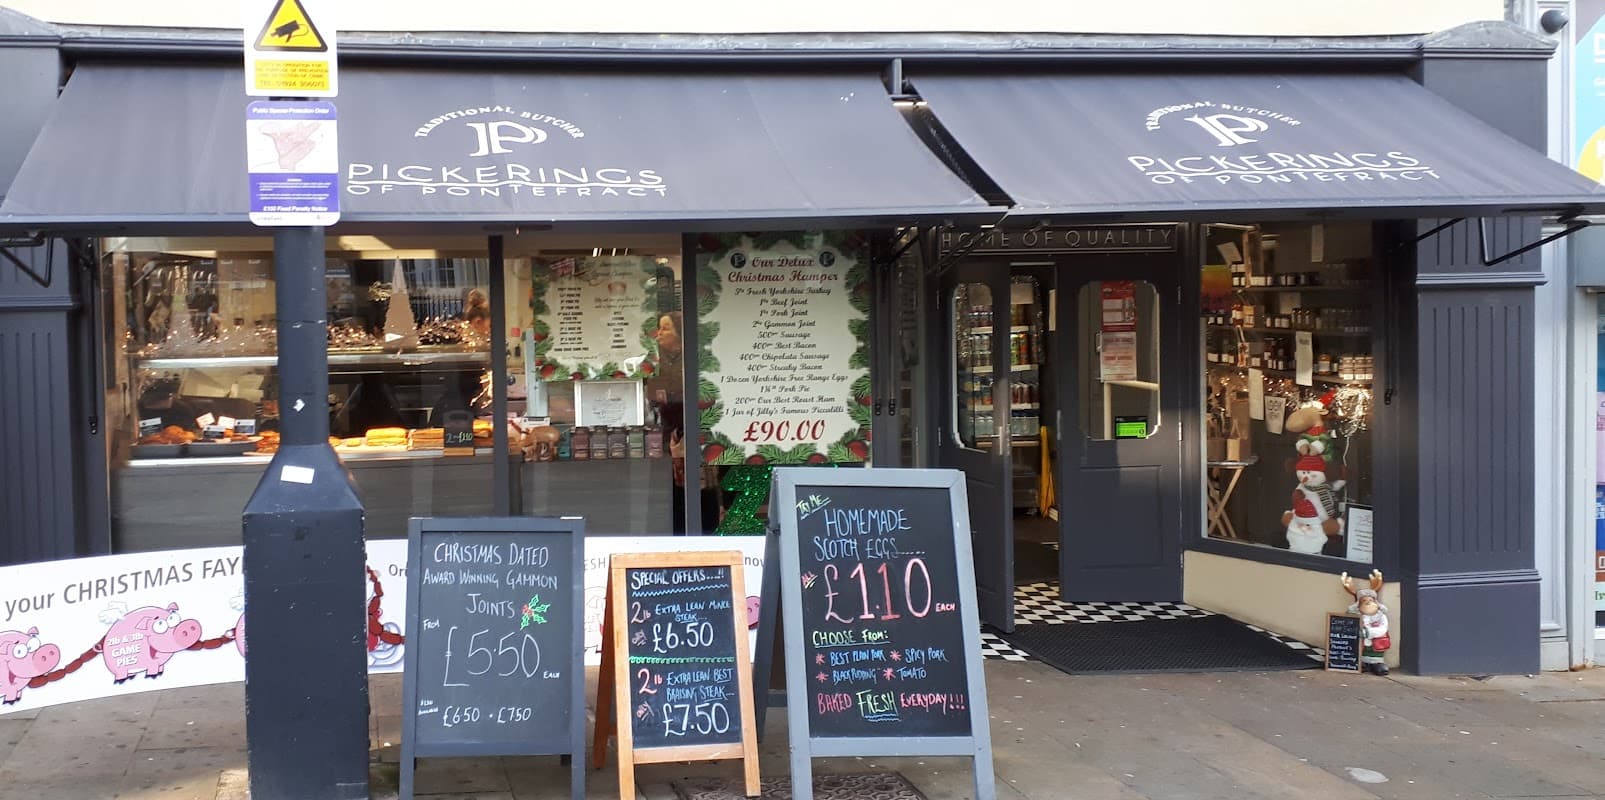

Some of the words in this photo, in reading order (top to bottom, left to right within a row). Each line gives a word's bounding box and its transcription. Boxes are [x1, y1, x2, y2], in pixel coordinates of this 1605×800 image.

[414, 104, 514, 138] TRADITIONAL
[520, 110, 585, 139] BUTCHER
[1145, 100, 1216, 132] TRADITIONAL
[1220, 103, 1303, 127] BUTCHER
[1127, 152, 1421, 173] PICKERINGS
[348, 163, 666, 185] PICKERINGS
[1151, 173, 1195, 185] OF
[1218, 170, 1441, 185] PONTEFRACT
[346, 184, 394, 196] OF
[422, 184, 667, 198] PONTEFRACT
[1023, 230, 1053, 247] OF
[1065, 229, 1172, 247] QUALITY
[752, 256, 773, 268] Our
[728, 271, 785, 283] Christmas
[788, 270, 838, 284] Hamper
[768, 287, 804, 297] Yorkshire
[770, 298, 787, 308] Beef
[790, 298, 808, 308] Joint
[770, 309, 788, 317] Pork
[790, 309, 808, 318] Joint
[764, 320, 796, 329] Gammon
[798, 319, 816, 329] Joint
[780, 331, 811, 339] Sausage
[774, 341, 791, 349] Best
[793, 341, 817, 349] Bacon
[761, 352, 797, 362] Chipolata
[800, 352, 830, 361] Sausage
[769, 363, 797, 372] Streaky
[799, 363, 823, 371] Bacon
[725, 375, 749, 383] Dozen
[751, 374, 787, 384] Yorkshire
[788, 374, 804, 382] Free
[805, 373, 830, 382] Range
[831, 373, 849, 382] Eggs
[778, 385, 797, 393] Pork
[798, 384, 810, 392] Pie
[757, 396, 772, 404] Our
[773, 396, 790, 404] Best
[792, 396, 814, 404] Roast
[816, 395, 836, 403] Ham
[732, 408, 744, 416] Jar
[746, 408, 755, 417] of
[780, 406, 809, 414] Famous
[743, 418, 826, 443] £90.00
[824, 508, 912, 537] HOMEMADE
[434, 542, 502, 565] CHRISTMAS
[508, 542, 549, 568] DATED
[813, 536, 860, 562] SCOTCH
[422, 567, 455, 585] AWARD
[459, 568, 499, 589] WINNING
[506, 569, 558, 590] GAMMON
[631, 569, 669, 590] SPECIAL
[5, 589, 55, 622] your
[63, 561, 194, 606] CHRISTMAS
[824, 558, 932, 624] £1.10
[935, 602, 956, 612] EACH
[466, 592, 515, 618] JOINTS
[655, 603, 681, 616] EXTRA
[685, 602, 705, 611] LEAN
[652, 622, 714, 654] £6.50
[812, 630, 857, 646] CHOOSE
[862, 628, 889, 643] FROM:
[112, 643, 142, 658] GAME
[830, 650, 850, 667] BEST
[852, 649, 869, 662] PLAIN
[871, 648, 887, 662] PORK
[904, 647, 926, 665] SPICY
[928, 647, 949, 663] PORK
[116, 655, 138, 668] PIES
[543, 670, 560, 680] EACH
[666, 671, 691, 687] EXTRA
[692, 668, 710, 682] LEAN
[714, 668, 733, 683] BEST
[832, 668, 852, 686] BLACK
[851, 667, 878, 685] PUDDING
[896, 667, 927, 682] TOMATO
[666, 687, 698, 702] BRAISING
[817, 692, 853, 714] BAKED
[856, 689, 899, 716] FRESH
[662, 702, 730, 737] £7.50
